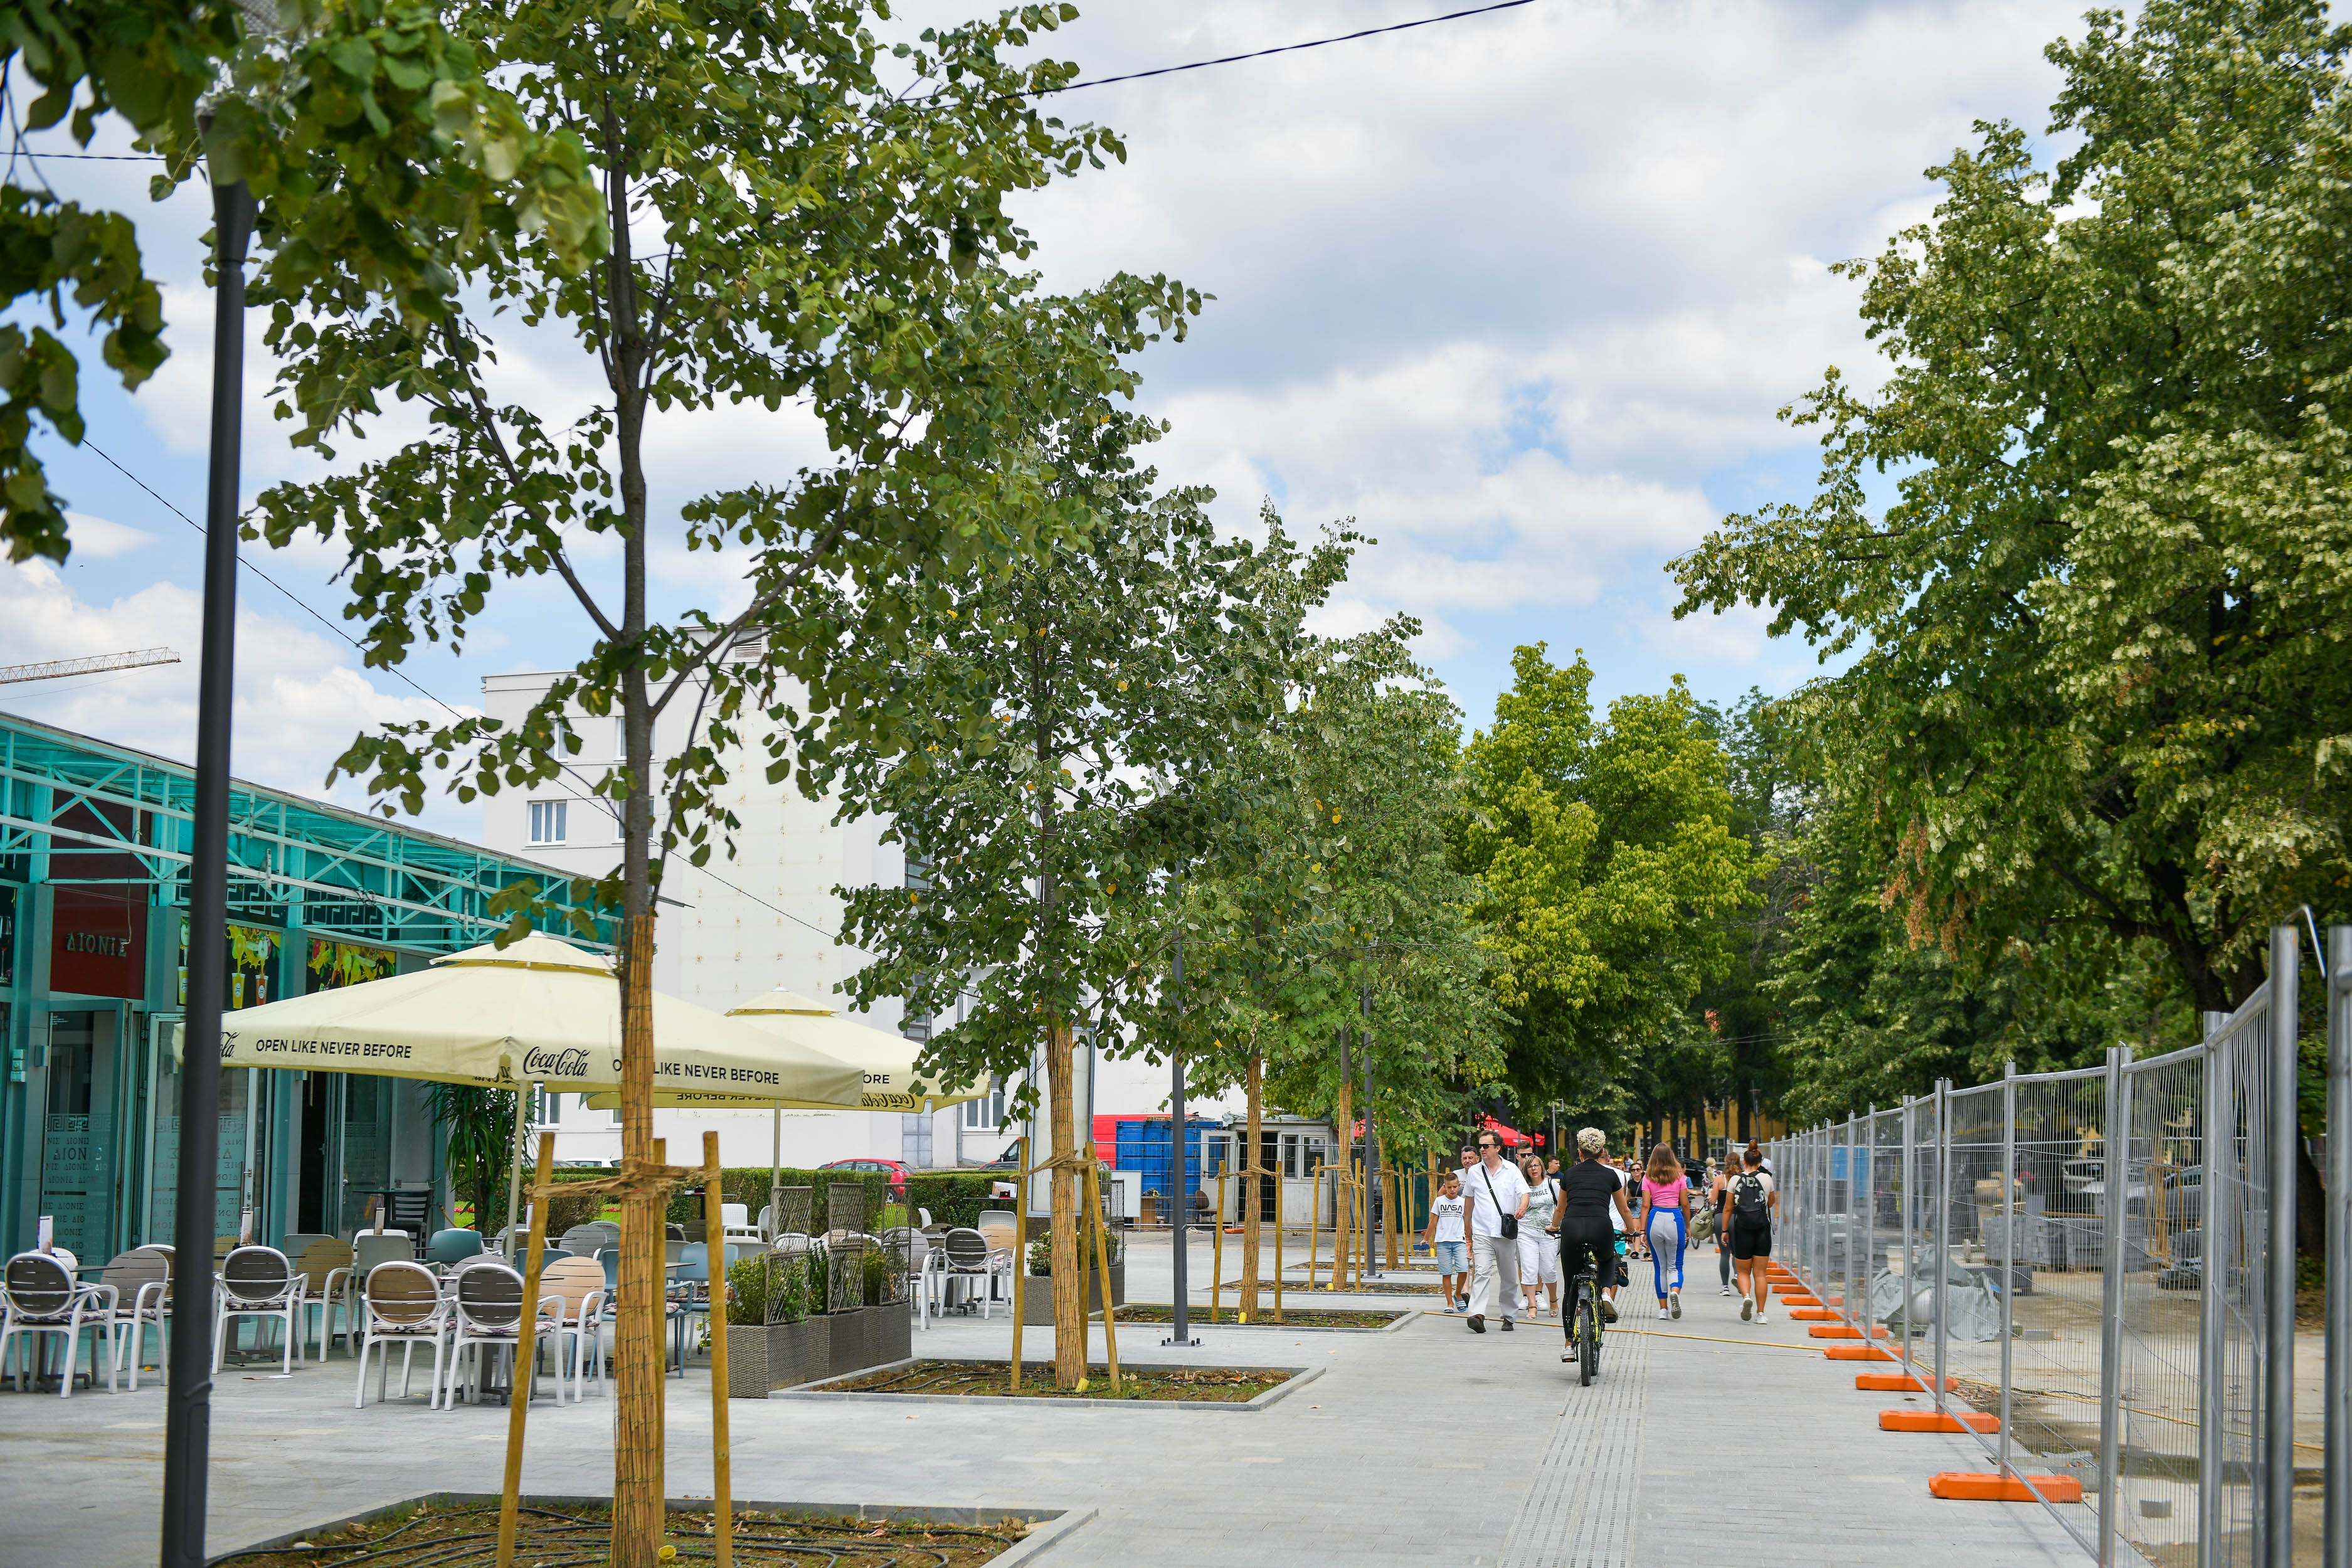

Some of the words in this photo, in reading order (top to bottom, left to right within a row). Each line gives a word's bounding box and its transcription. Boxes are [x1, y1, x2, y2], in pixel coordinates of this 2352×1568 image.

[256, 1039, 289, 1052] OPEN
[291, 1040, 317, 1053] LIKE
[320, 1041, 360, 1056] NEVER
[363, 1043, 412, 1059] BEFORE
[523, 1046, 591, 1077] Coca-Cola
[685, 1064, 727, 1080] NEVER
[731, 1068, 780, 1085] BEFORE
[863, 1074, 890, 1084] ORE
